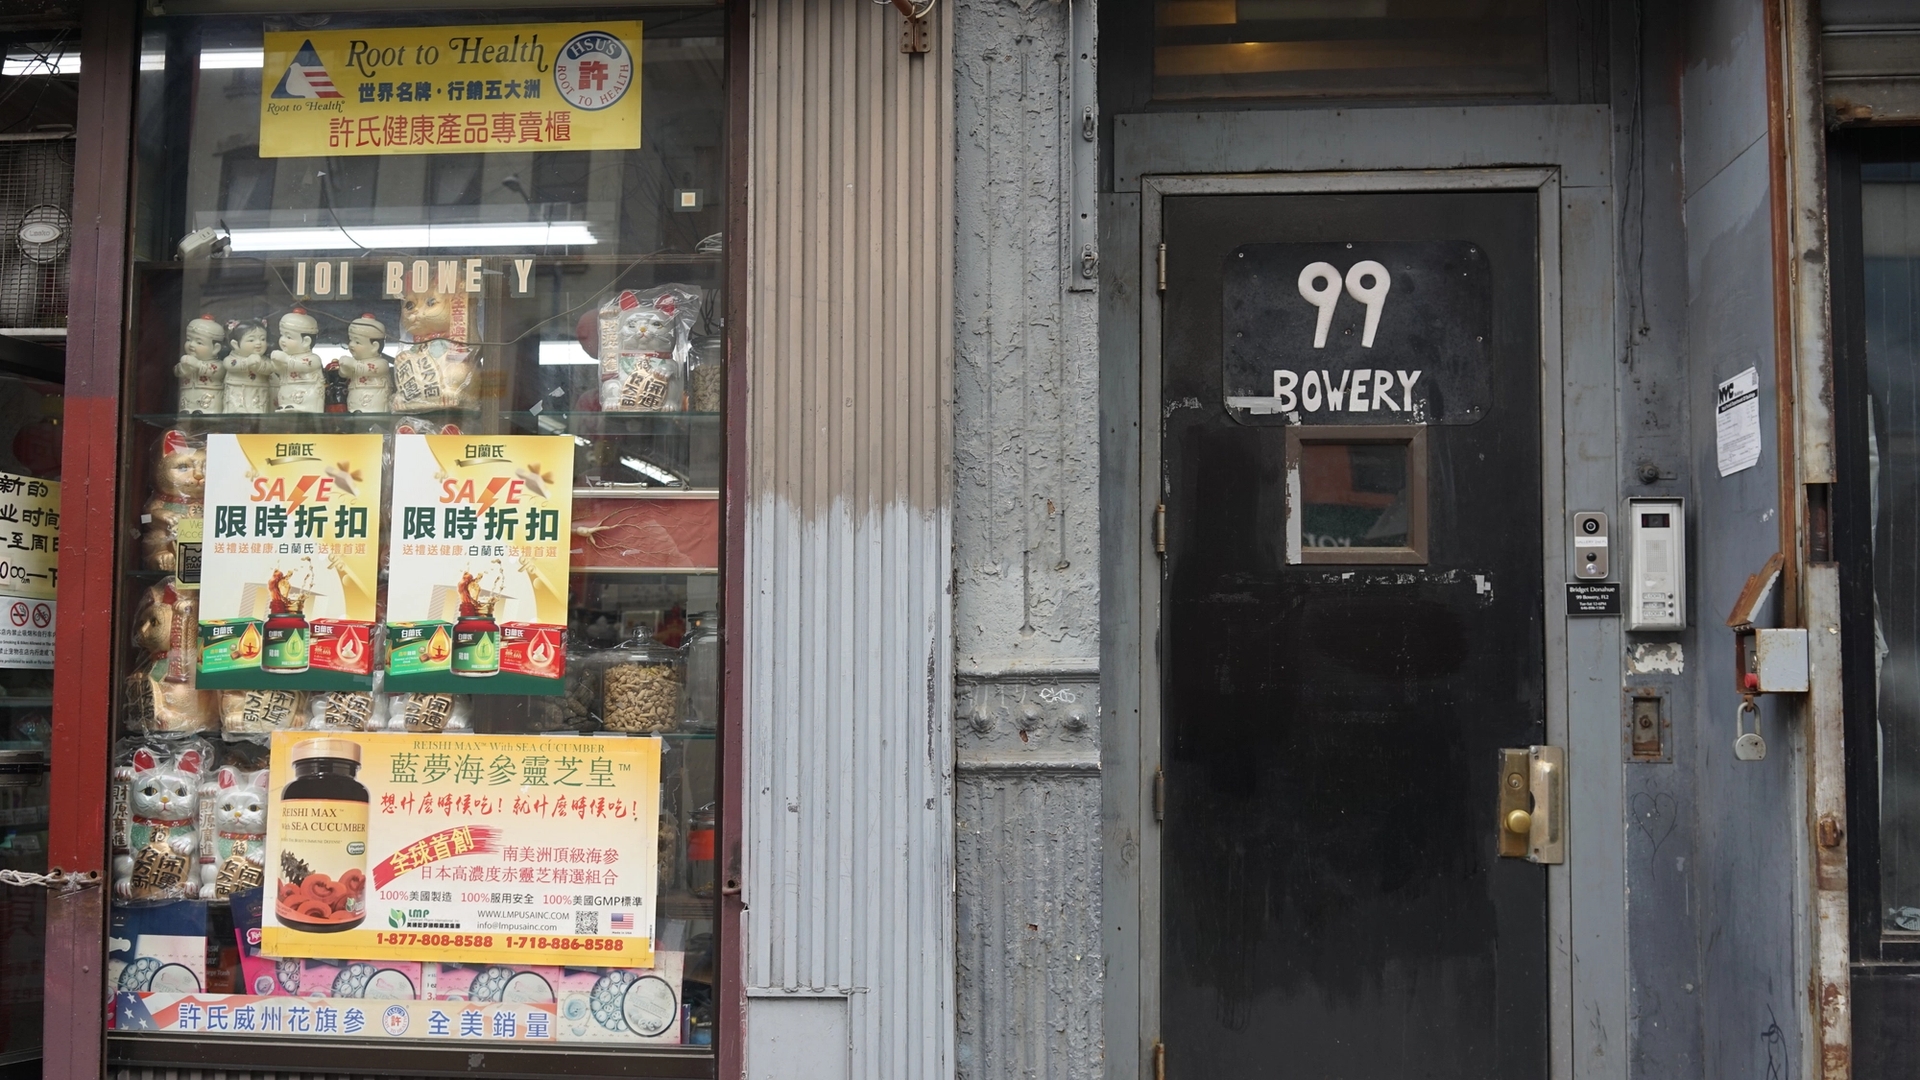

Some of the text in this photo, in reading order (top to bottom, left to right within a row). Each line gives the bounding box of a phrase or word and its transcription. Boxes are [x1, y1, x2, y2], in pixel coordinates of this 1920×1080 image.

[345, 34, 549, 77] Root to Health
[570, 38, 617, 57] HSU'S
[558, 64, 629, 106] ROOT TO HEALTH
[578, 61, 608, 90] 許
[267, 103, 289, 115] Root
[329, 110, 571, 148] 許氏健康產品專賣櫃
[1298, 260, 1391, 348] 99
[1274, 369, 1422, 412] BOWERY
[1718, 382, 1734, 404] NYC
[214, 505, 368, 539] 限時折扣
[403, 506, 559, 541] 限時折扣
[413, 741, 451, 750] REISHI
[490, 742, 513, 751] With
[516, 743, 537, 752] SEA
[541, 743, 605, 753] CUCUMBER
[390, 753, 616, 787] 藍夢海參靈芝皇
[282, 808, 308, 817] REISHI
[291, 822, 308, 831] SEA
[311, 822, 366, 832] CUCUMBER
[390, 825, 474, 877] 全球首創
[503, 845, 619, 865] 南美洲頂級海參
[421, 865, 619, 885] 日本高濃度赤靈芝精選組合
[380, 890, 643, 907] 100%美國製造 100%服用安全 100%美國GMP標準
[409, 909, 430, 918] LMP
[477, 910, 570, 920] WWW.LMPUSAINC.COM
[477, 922, 557, 931] info@lmpusainc.com
[377, 933, 624, 951] 1-877-808-8588 1-718-886-8588
[179, 1004, 365, 1034] 許氏威州花旗參
[428, 1011, 550, 1038] 全美銷量
